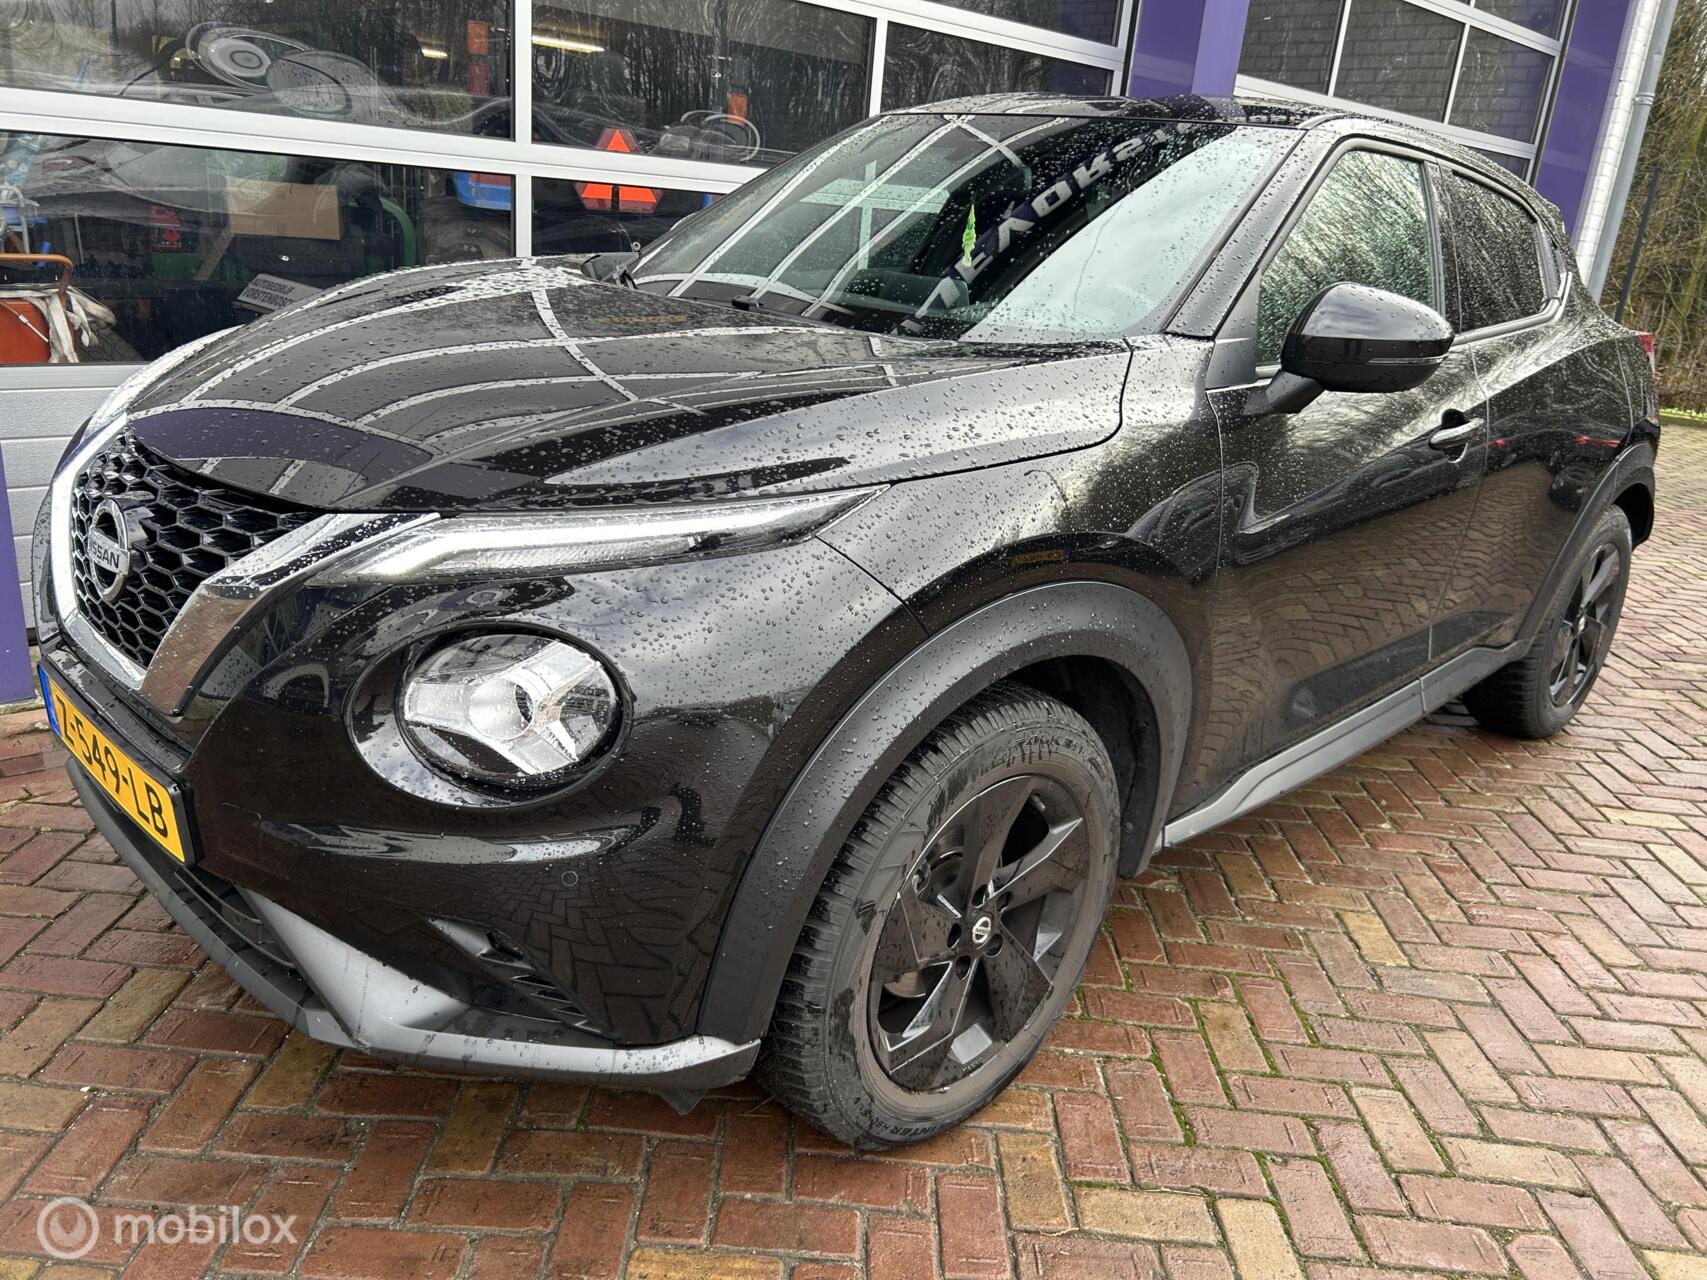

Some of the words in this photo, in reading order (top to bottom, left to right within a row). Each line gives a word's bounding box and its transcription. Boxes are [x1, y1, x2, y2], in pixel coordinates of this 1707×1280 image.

[241, 286, 295, 308] VORSTENBOSC
[251, 279, 296, 295] AUTOBEDRIJF
[55, 694, 169, 838] Z-549-LB
